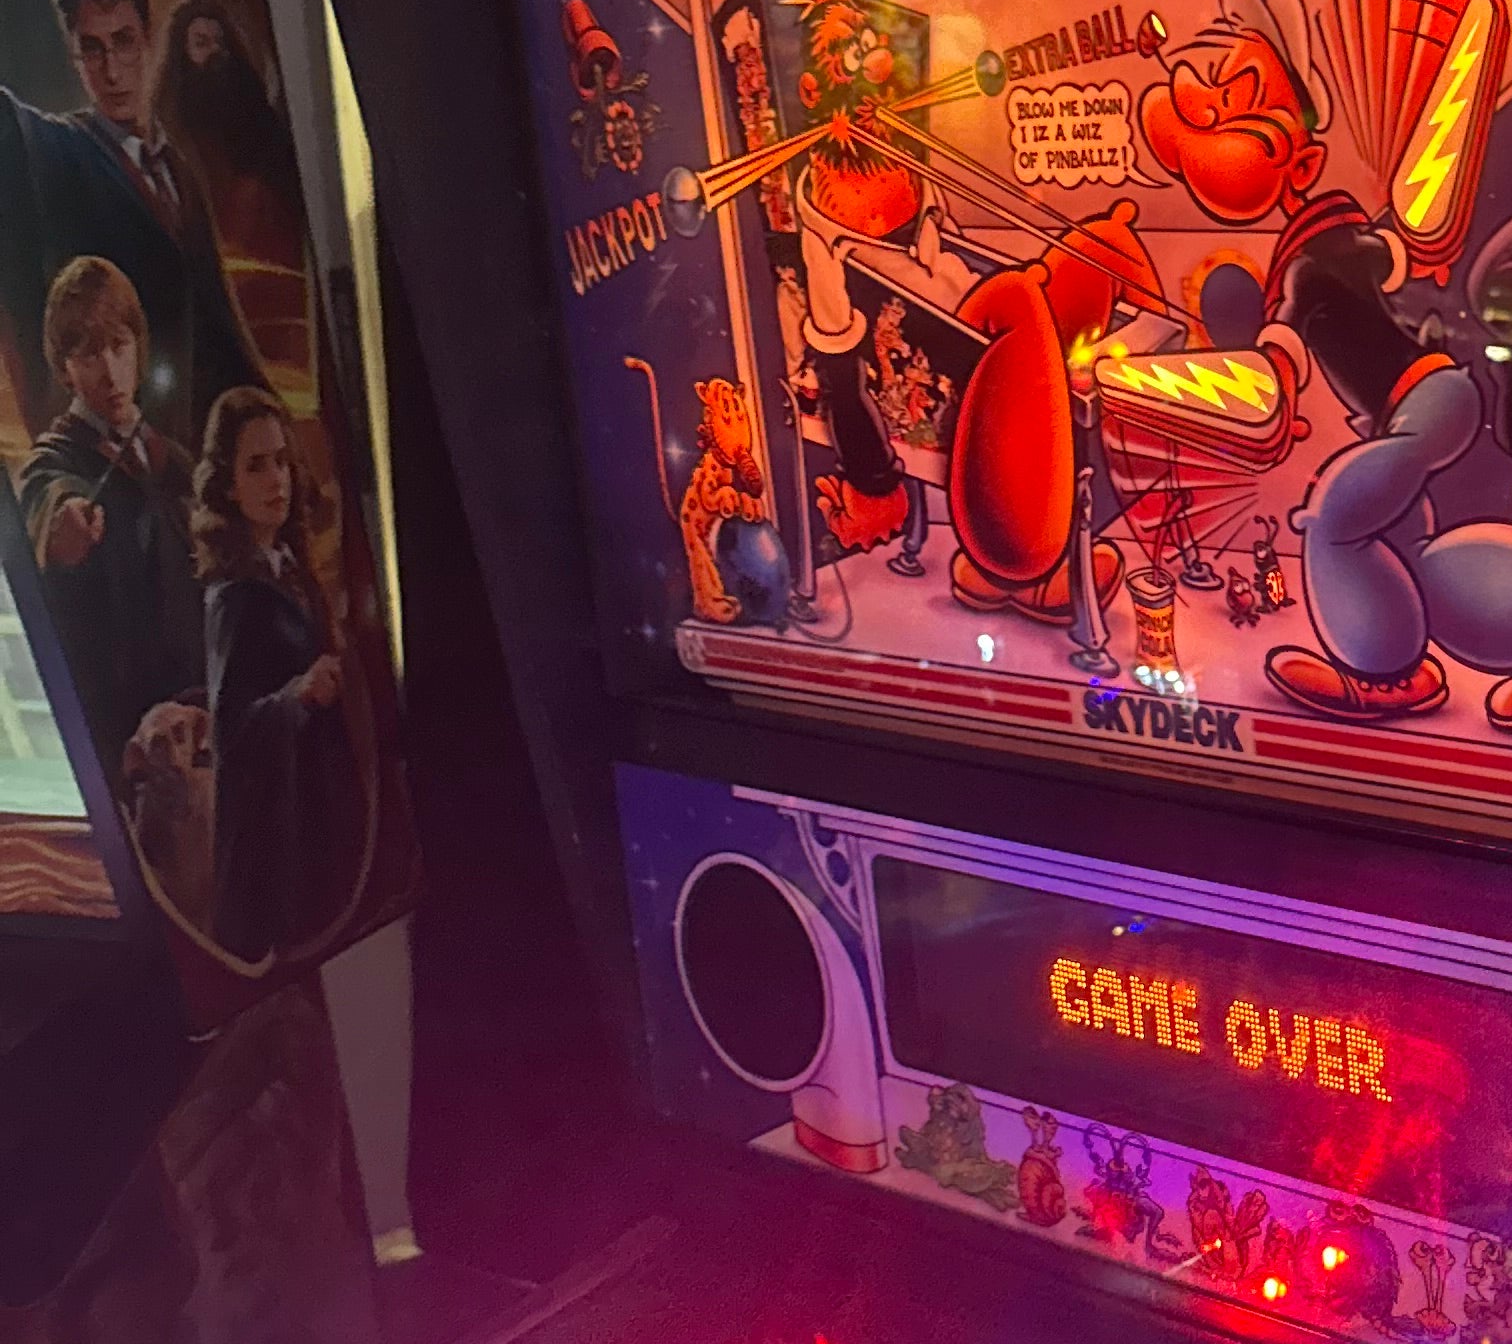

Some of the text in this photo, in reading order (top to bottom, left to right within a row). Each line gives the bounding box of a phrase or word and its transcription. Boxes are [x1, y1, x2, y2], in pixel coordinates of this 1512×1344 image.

[1003, 4, 1136, 81] EXTRA BALL
[1016, 98, 1124, 120] BLOW ME DOWN
[1021, 123, 1102, 143] I IZ A WIZ
[1019, 152, 1038, 169] OF
[564, 191, 668, 297] JACKPOT
[1082, 690, 1245, 754] SKYDECK
[1048, 957, 1393, 1104] GAME OVER
